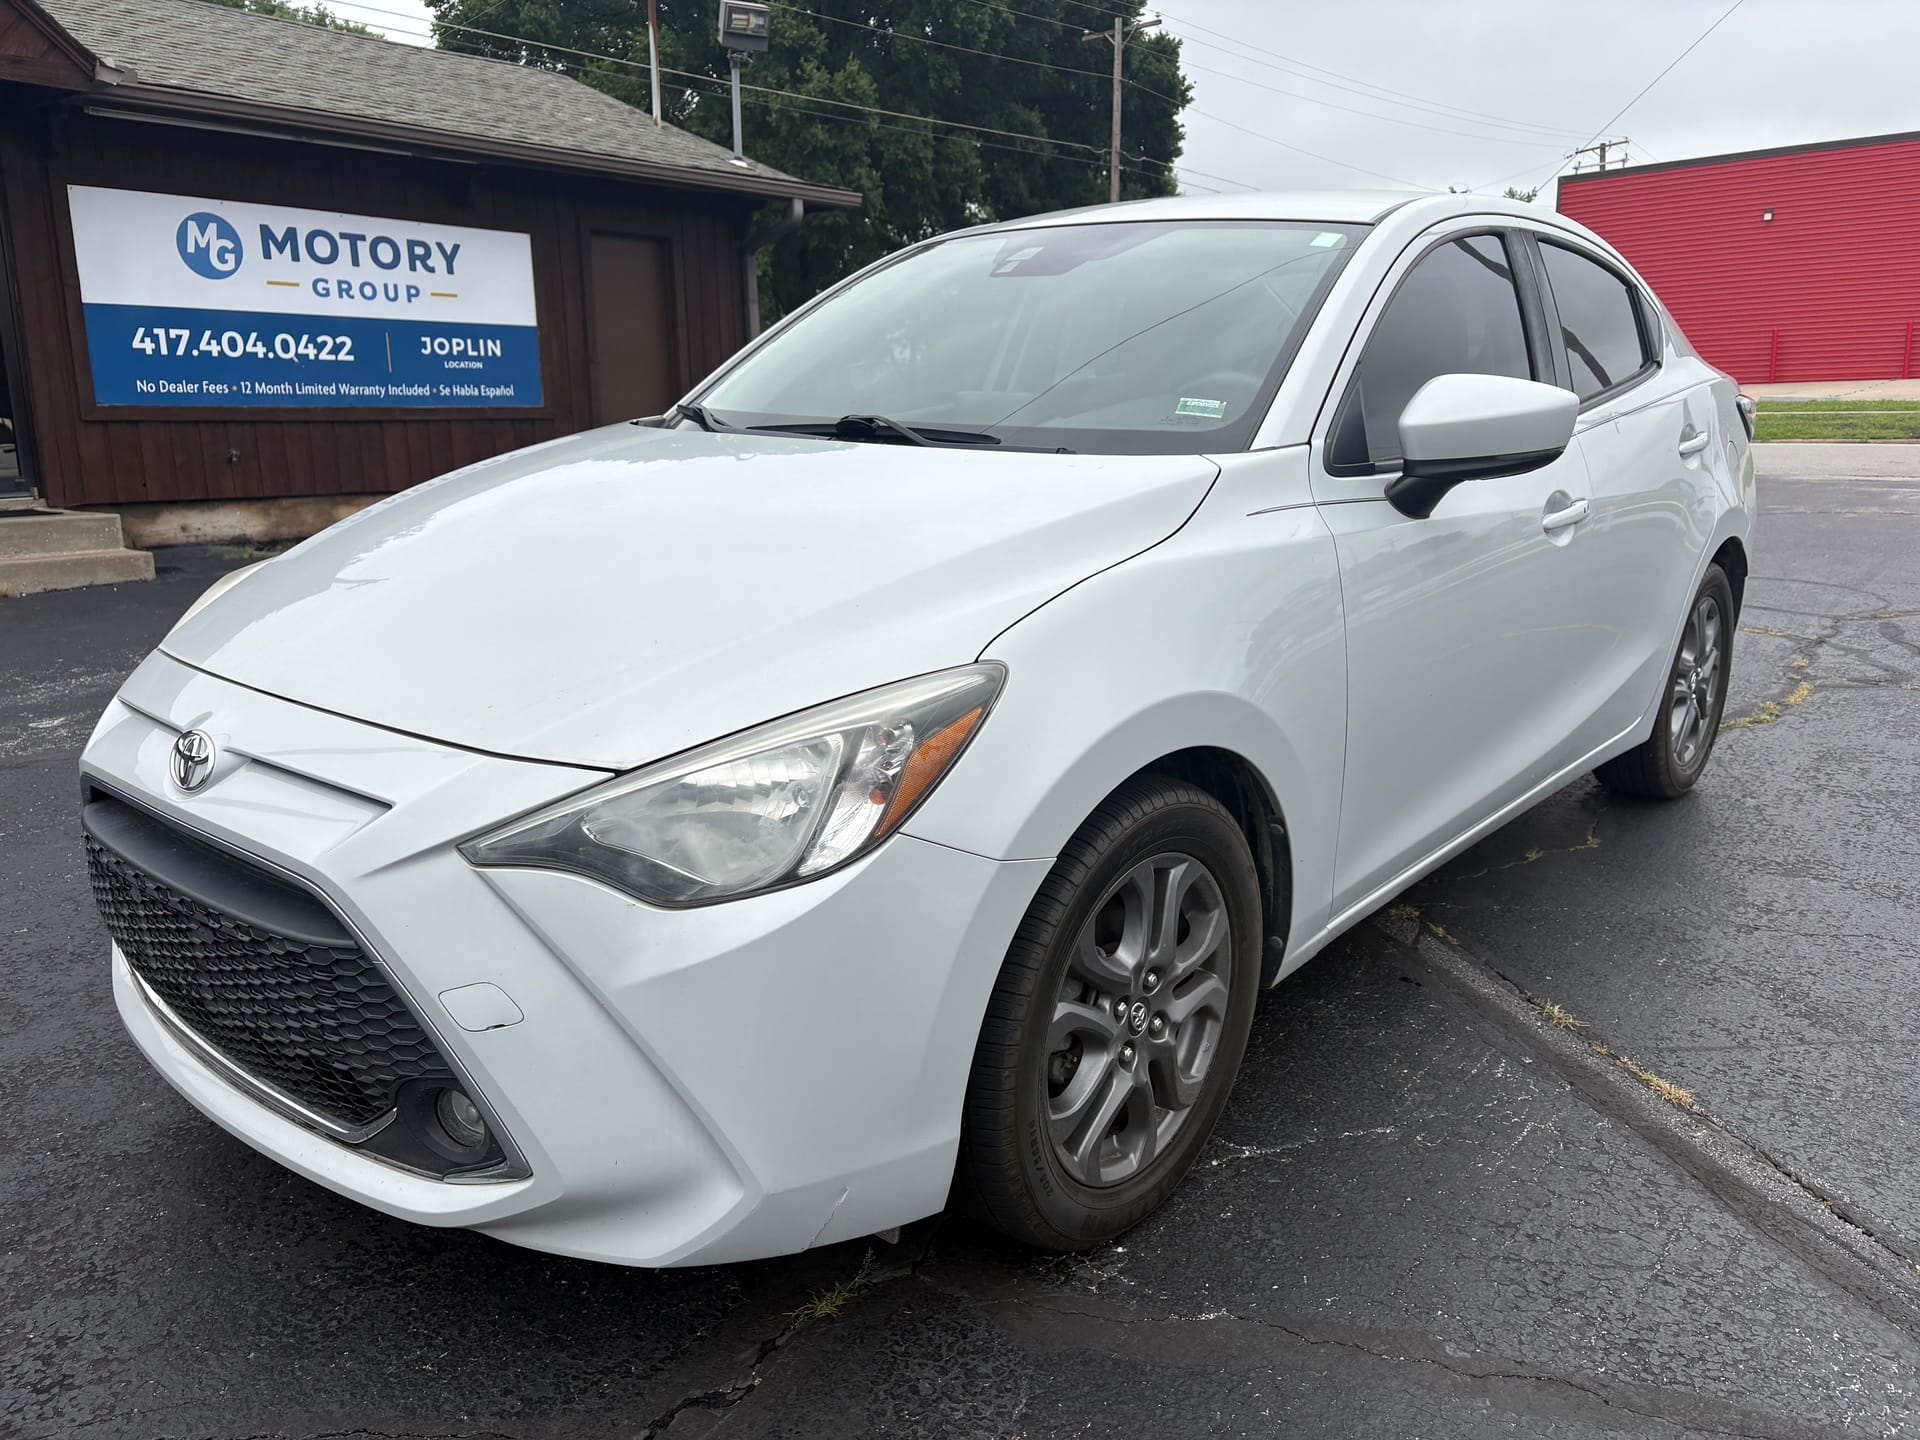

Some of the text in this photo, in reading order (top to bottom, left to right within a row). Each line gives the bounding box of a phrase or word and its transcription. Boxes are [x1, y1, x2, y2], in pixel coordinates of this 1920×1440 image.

[187, 220, 236, 271] MG
[259, 223, 461, 275] MOTORY
[311, 277, 421, 303] GROUP
[132, 327, 355, 361] 417.404.0422
[420, 337, 502, 357] JOPLIN
[444, 361, 483, 369] LOCATION
[136, 380, 515, 398] No Dealer Fees 12 Month Limited Warranty Included Se Habla Español
